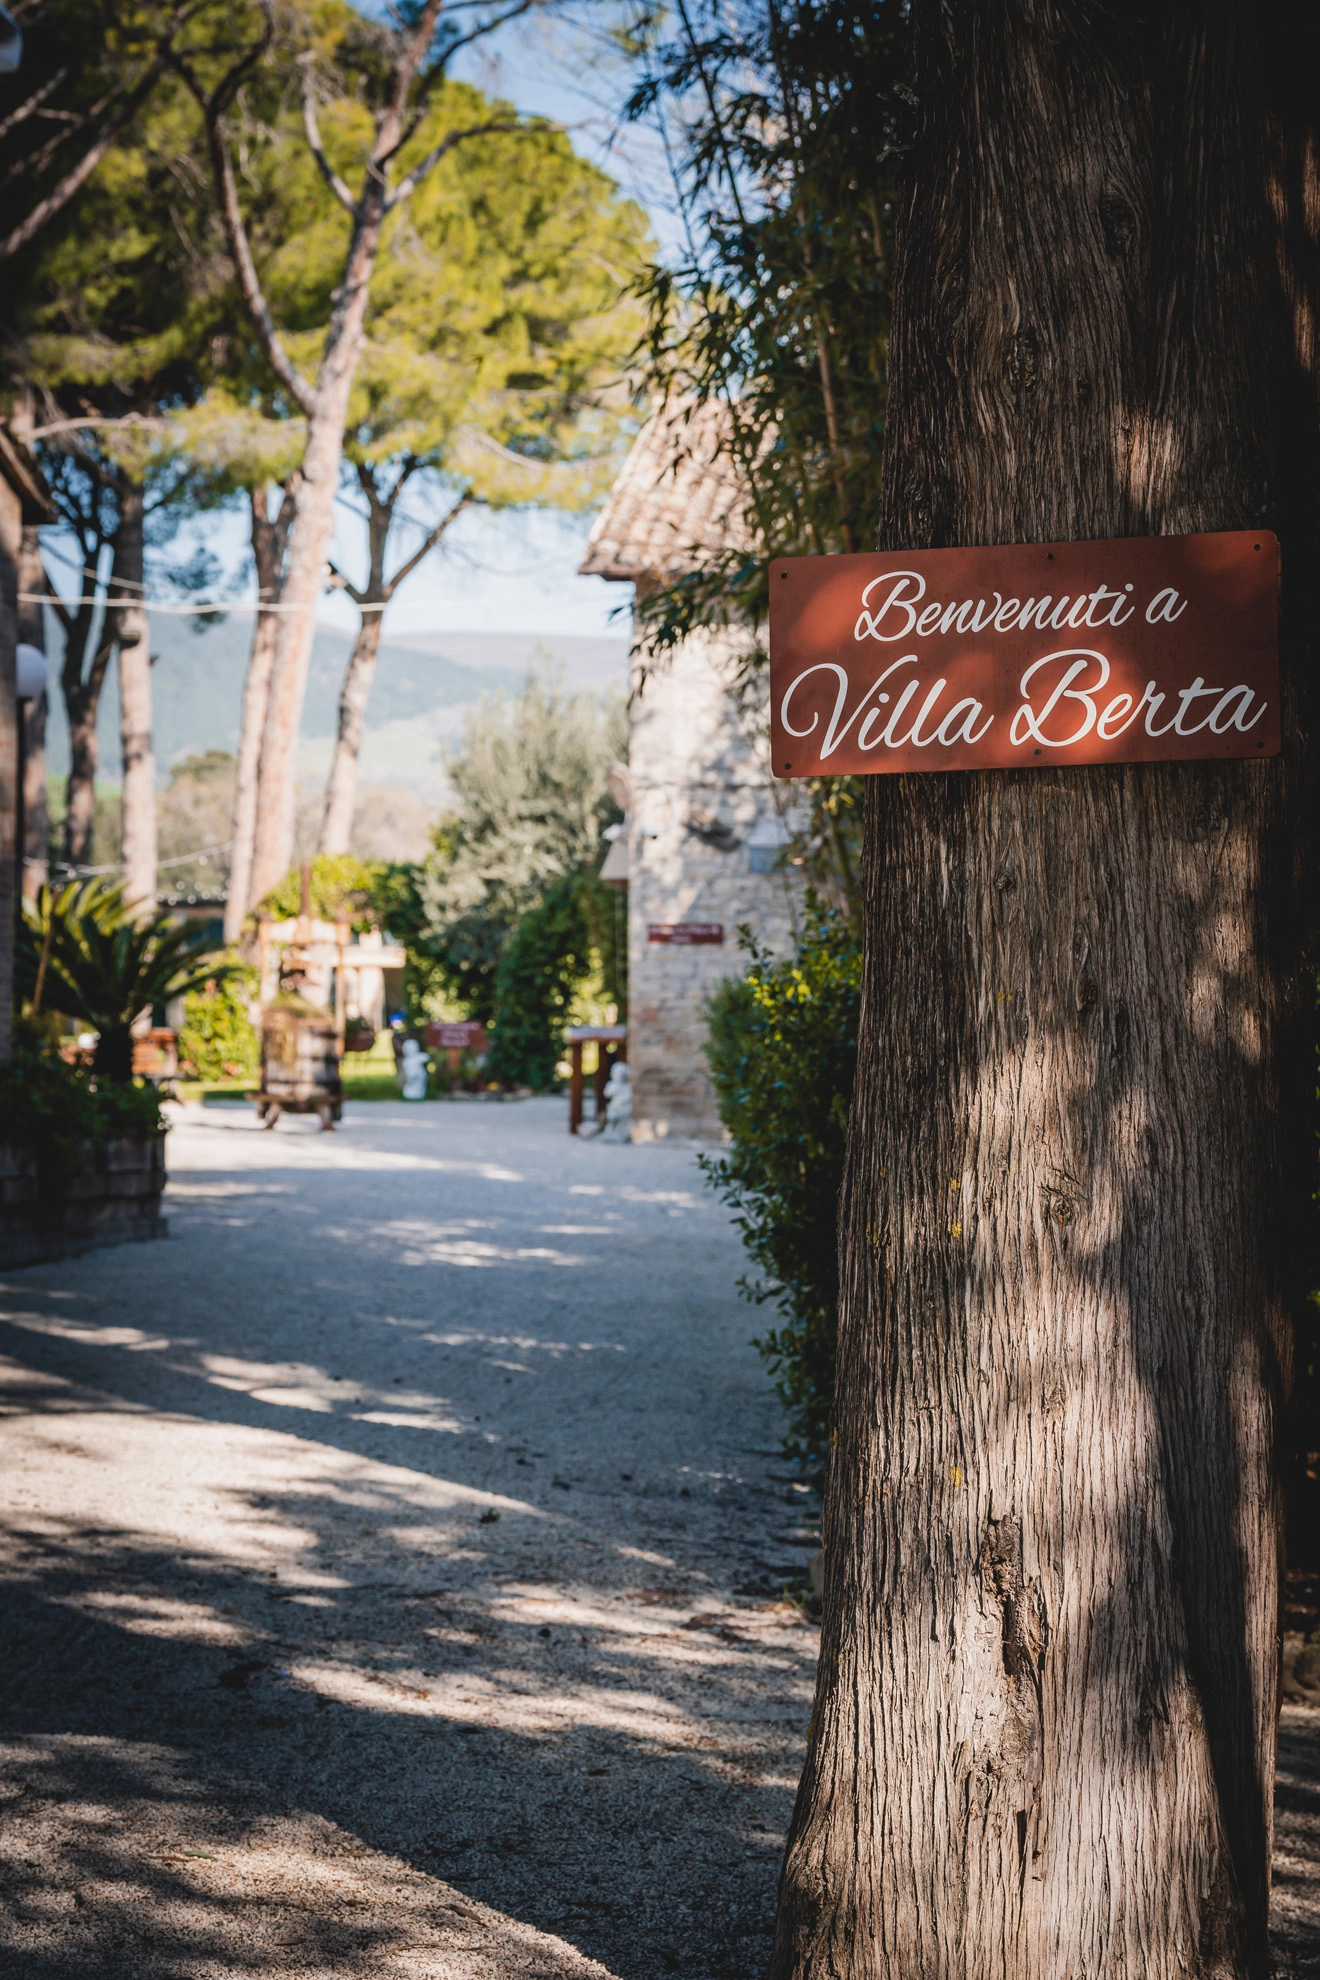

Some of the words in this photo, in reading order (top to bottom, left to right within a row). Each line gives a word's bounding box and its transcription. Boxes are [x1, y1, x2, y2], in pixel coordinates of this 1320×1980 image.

[853, 570, 1136, 642] Benvenuti
[1145, 587, 1188, 624] a
[780, 654, 995, 761] Villa
[1009, 648, 1268, 748] Berta
